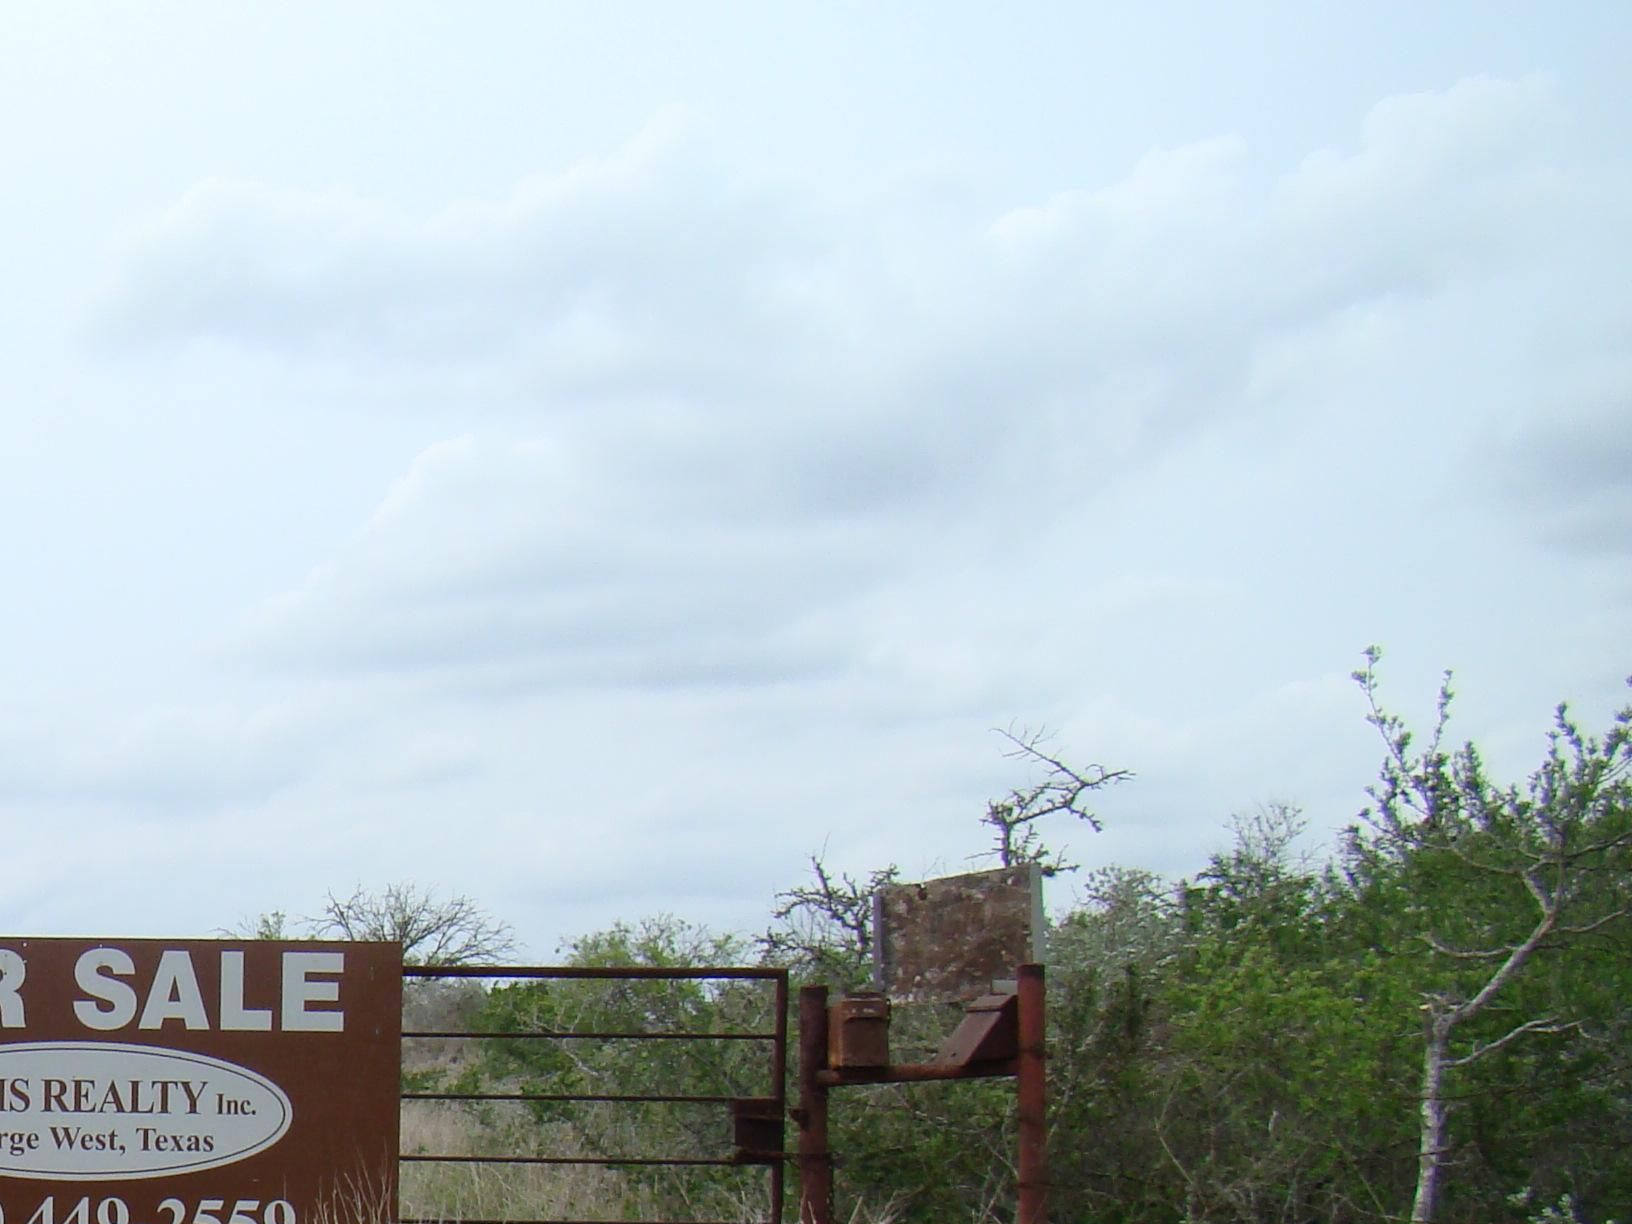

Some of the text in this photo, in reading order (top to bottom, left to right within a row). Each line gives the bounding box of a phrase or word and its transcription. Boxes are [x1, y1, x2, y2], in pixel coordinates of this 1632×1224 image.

[73, 947, 345, 1032] SALE
[41, 1078, 207, 1115] REALTY
[215, 1092, 257, 1117] Inc.
[49, 1127, 126, 1155] West,
[136, 1127, 214, 1153] Texas
